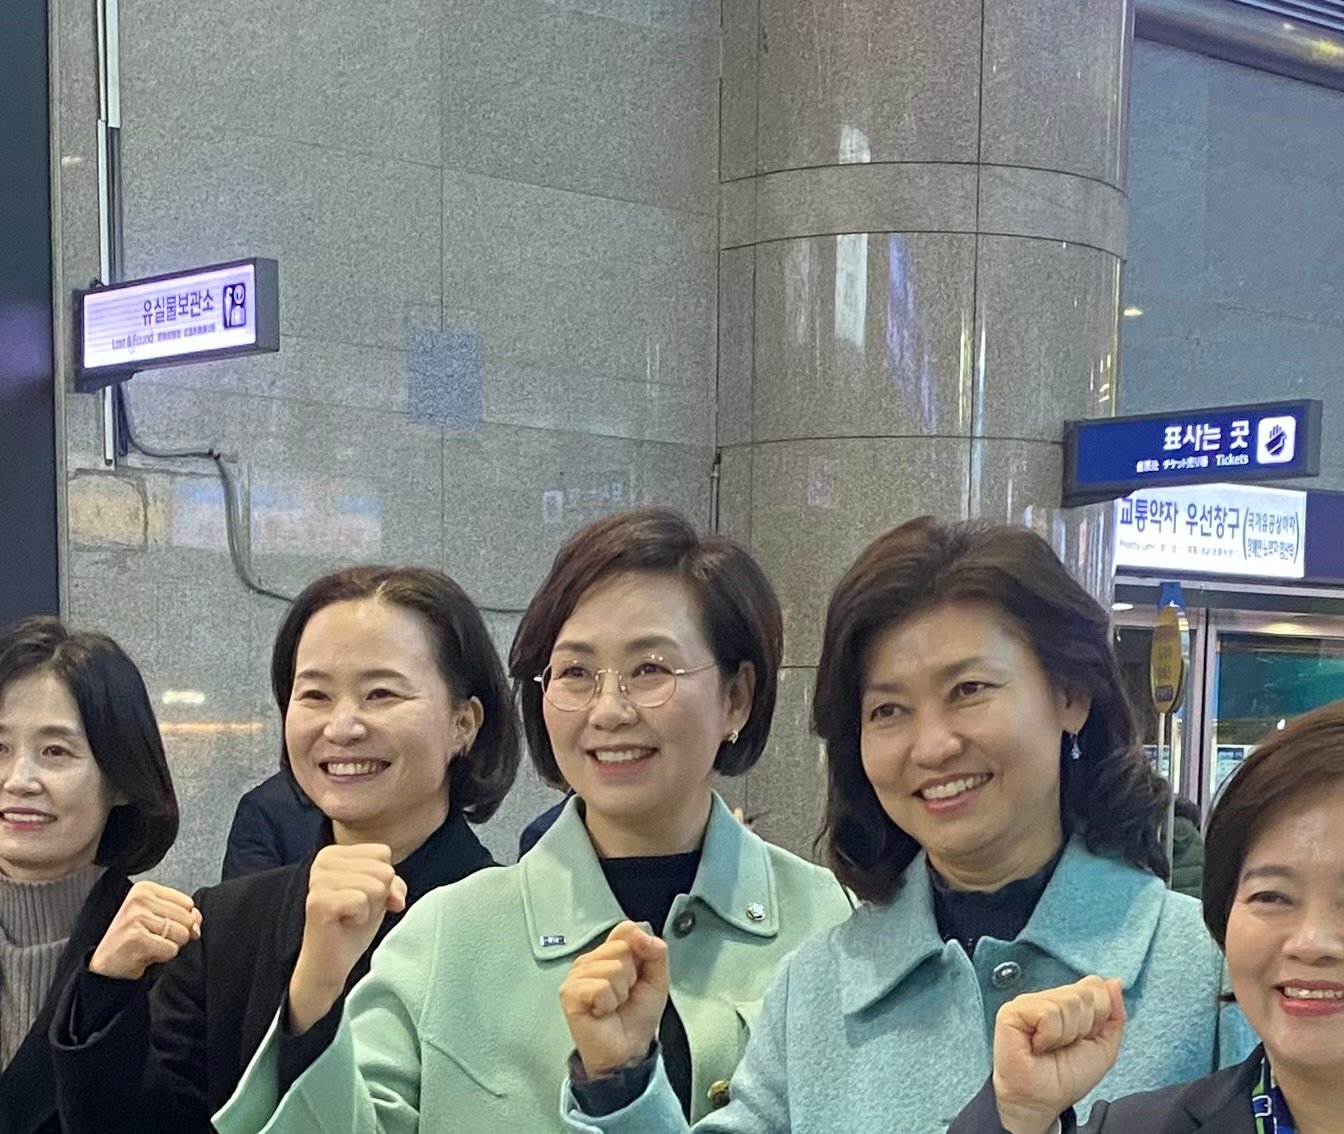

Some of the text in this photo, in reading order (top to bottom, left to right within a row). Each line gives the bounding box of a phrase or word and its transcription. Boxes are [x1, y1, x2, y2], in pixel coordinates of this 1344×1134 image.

[142, 290, 214, 325] 유실물보관소
[1163, 420, 1250, 451] 표사는 곳
[1215, 453, 1249, 466] Tickets
[1120, 497, 1240, 540] 교통약자 우선창구
